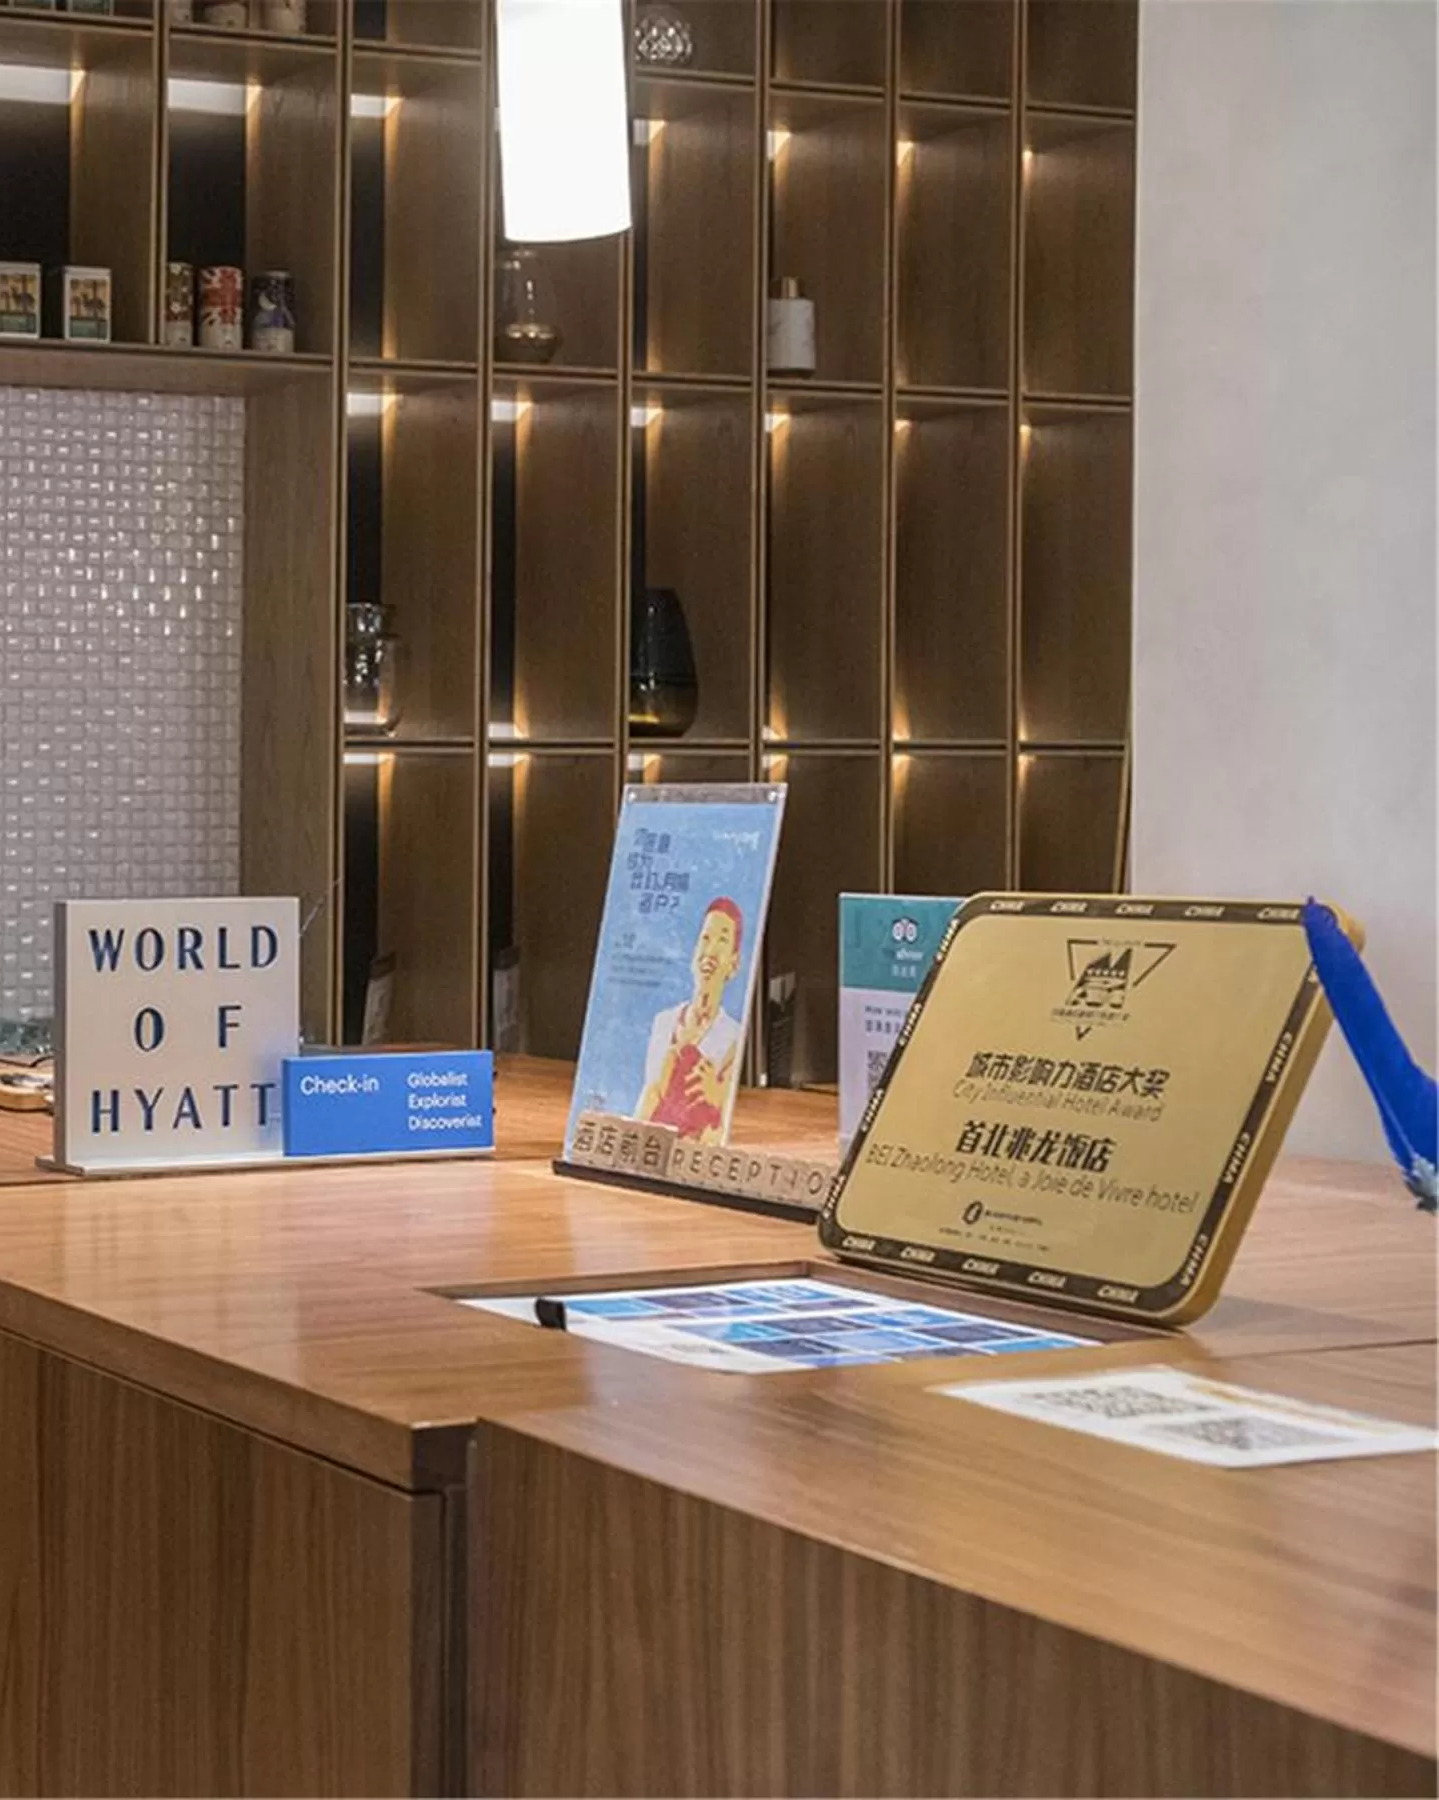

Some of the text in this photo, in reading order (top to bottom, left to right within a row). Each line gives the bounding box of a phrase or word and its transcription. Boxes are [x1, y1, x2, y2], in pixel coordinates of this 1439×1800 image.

[88, 926, 279, 972] WORLD
[134, 1005, 243, 1052] OF
[300, 1074, 380, 1095] Check-in
[407, 1072, 468, 1088] Globalist
[966, 1051, 1170, 1099] 城市影响力酒店大奖
[92, 1082, 276, 1133] HYATT
[408, 1093, 468, 1110] Explorist
[408, 1114, 483, 1131] Discoverist
[1061, 1093, 1109, 1116] Hotel
[1106, 1099, 1164, 1123] Award
[955, 1119, 1118, 1174] 首北兆龙饭店
[673, 1147, 825, 1194] RECEPTIO
[889, 1147, 967, 1184] Zhaolong
[1069, 1174, 1095, 1199] de
[1144, 1184, 1200, 1214] hotel
